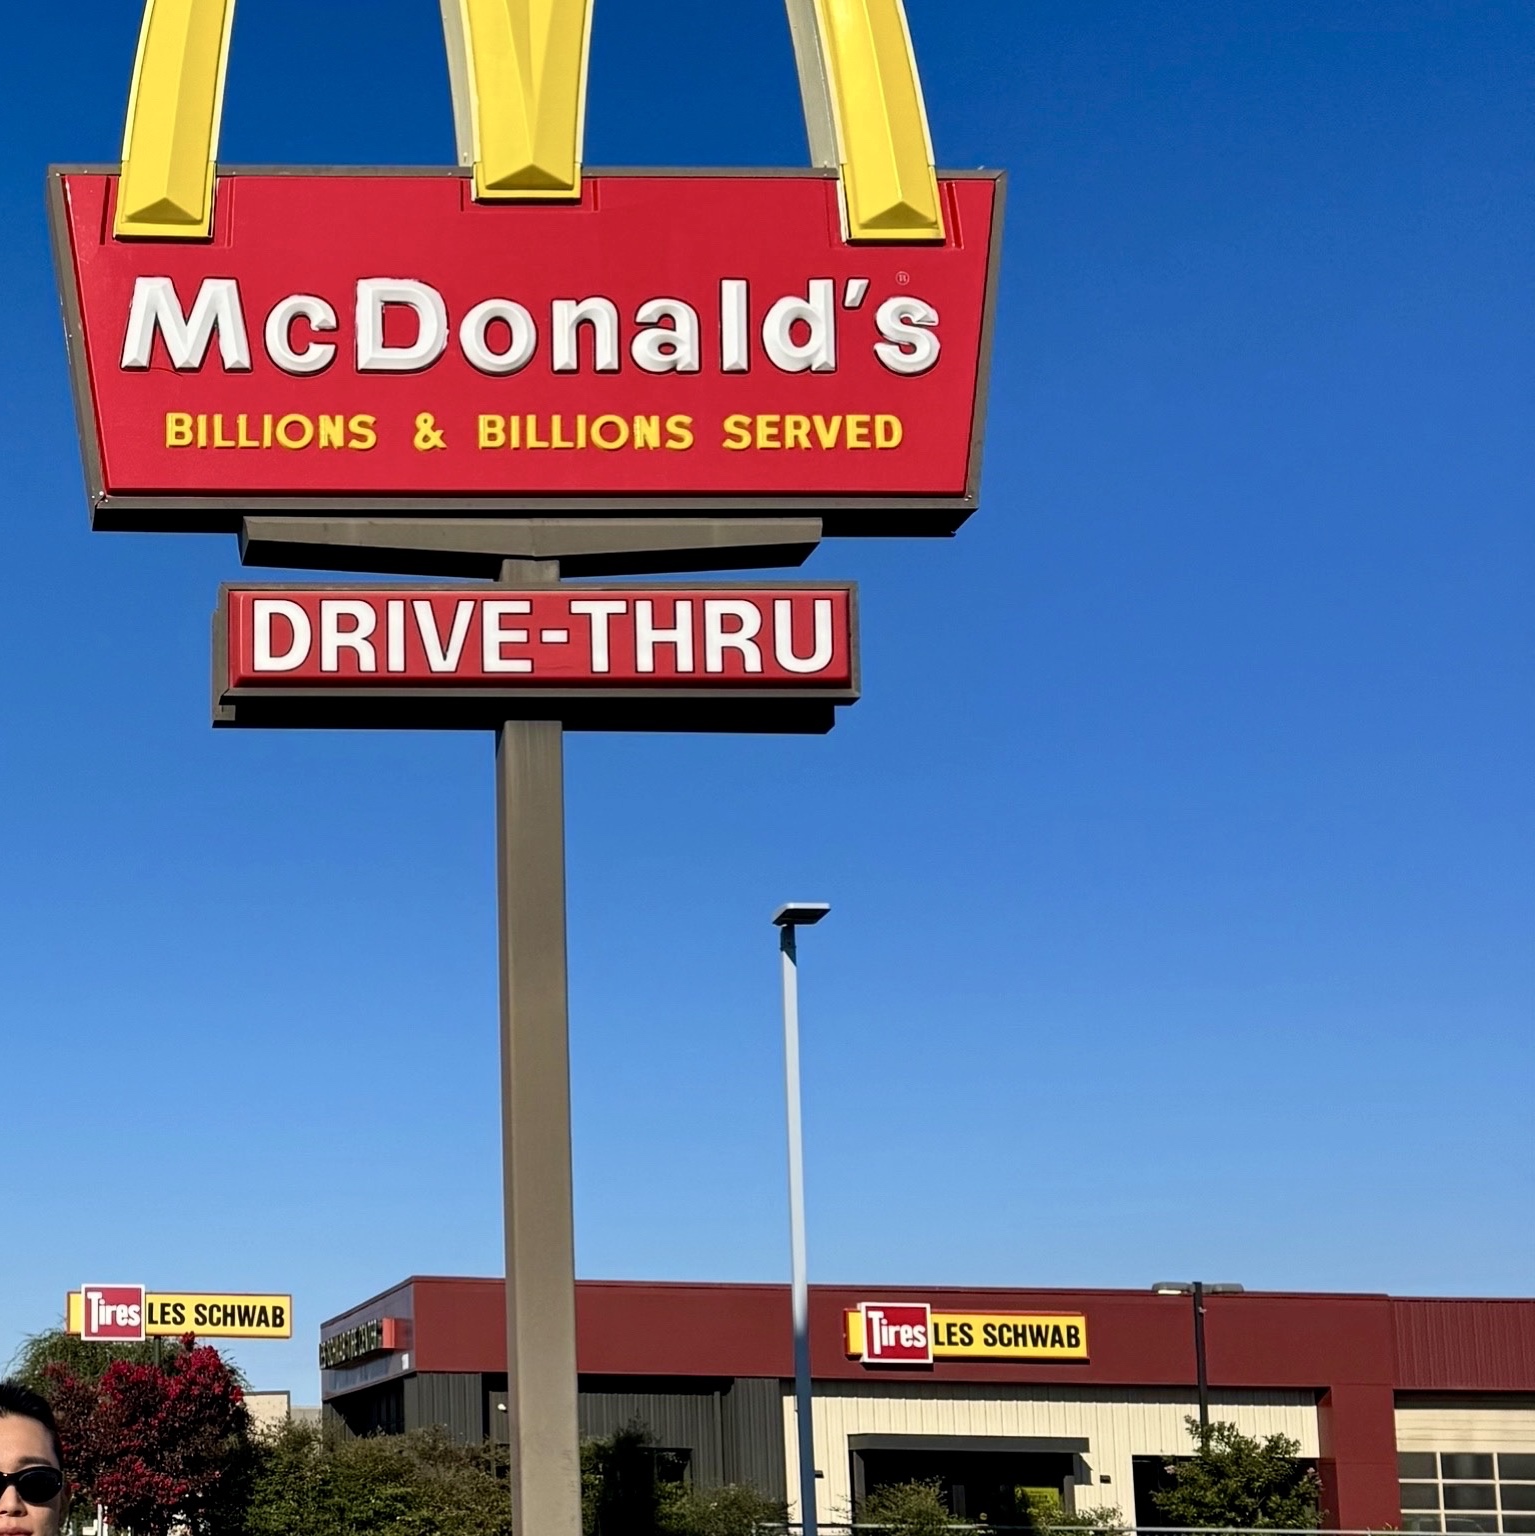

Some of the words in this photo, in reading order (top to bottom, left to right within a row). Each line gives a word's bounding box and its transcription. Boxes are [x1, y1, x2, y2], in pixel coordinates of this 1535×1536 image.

[119, 275, 942, 375] McDonald's
[165, 412, 377, 450] BILLIONS
[412, 411, 447, 451] &
[477, 413, 695, 450] BILLIONS
[722, 413, 904, 451] SERVED
[251, 598, 835, 675] DRIVE-THRU
[86, 1291, 141, 1334] Tires
[148, 1302, 186, 1326] LES
[194, 1303, 285, 1328] SCHWAB
[867, 1310, 927, 1355] Tires
[933, 1322, 974, 1347] LES
[982, 1323, 1081, 1349] SCHWAB
